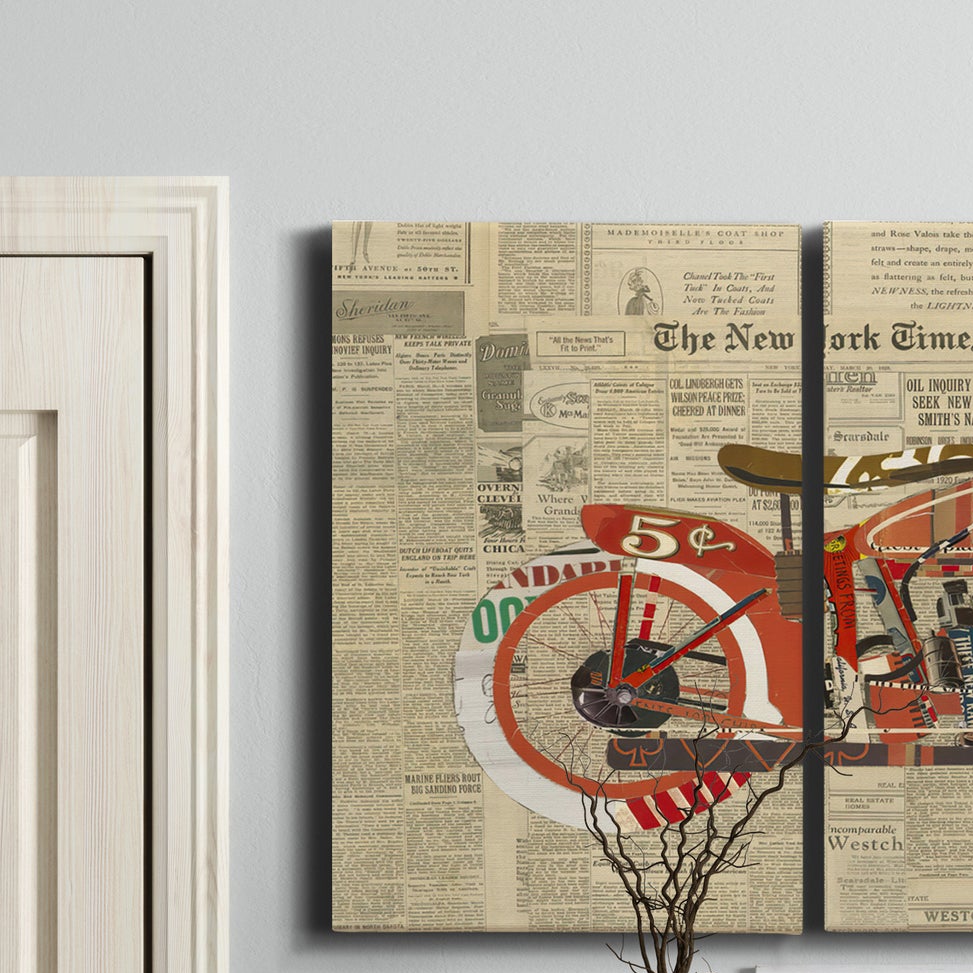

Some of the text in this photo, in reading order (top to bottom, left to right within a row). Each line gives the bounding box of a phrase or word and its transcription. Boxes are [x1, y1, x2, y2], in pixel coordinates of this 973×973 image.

[683, 272, 712, 280] Chanel
[714, 272, 732, 280] Took
[734, 272, 748, 280] The
[713, 284, 722, 292] In
[683, 295, 705, 303] Now
[749, 296, 774, 304] Coats
[692, 307, 765, 315] Are The Fashion
[654, 320, 795, 355] The New
[824, 323, 881, 351] ork
[561, 344, 569, 352] Fit
[725, 379, 743, 389] GETS
[907, 379, 924, 392] OIL
[929, 379, 971, 394] INQUIRY
[671, 392, 697, 403] WILSON
[699, 392, 720, 403] PEACE
[913, 396, 940, 409] SEEK
[948, 396, 971, 409] NEW
[673, 405, 745, 416] CHEERED AT DINNER
[918, 413, 960, 426] SMITH'S
[538, 495, 573, 503] Where
[405, 774, 481, 783] MARINE FLIERS ROUT
[411, 785, 481, 794] BIG SANDINO FORCE
